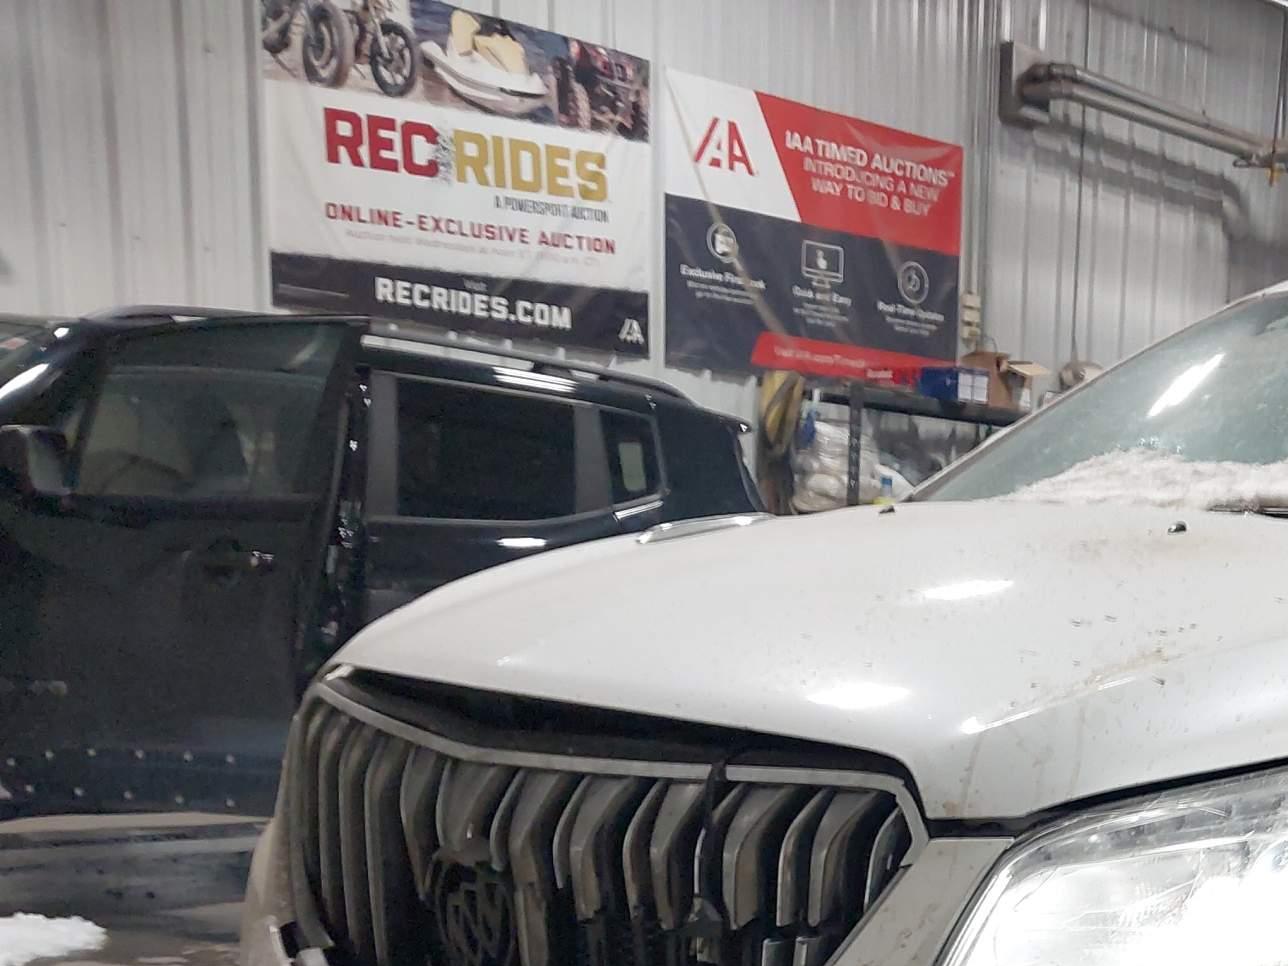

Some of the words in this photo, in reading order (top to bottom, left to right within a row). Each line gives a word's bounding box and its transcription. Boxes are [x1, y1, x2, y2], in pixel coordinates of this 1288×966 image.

[324, 107, 440, 178] REC
[453, 127, 609, 203] RIDES
[785, 130, 814, 155] IAA
[815, 138, 868, 168] TIMED
[803, 157, 895, 191] INTRODUCING
[896, 180, 908, 195] A
[909, 182, 940, 202] NEW
[811, 177, 844, 196] WAY
[847, 184, 866, 202] TO
[866, 190, 889, 208] BID
[890, 195, 901, 210] &
[903, 196, 931, 216] BUY
[325, 202, 530, 245] ONLINE-EXCLUSIVE
[538, 230, 616, 255] AUCTION
[374, 276, 572, 330] RECRIDES.COM
